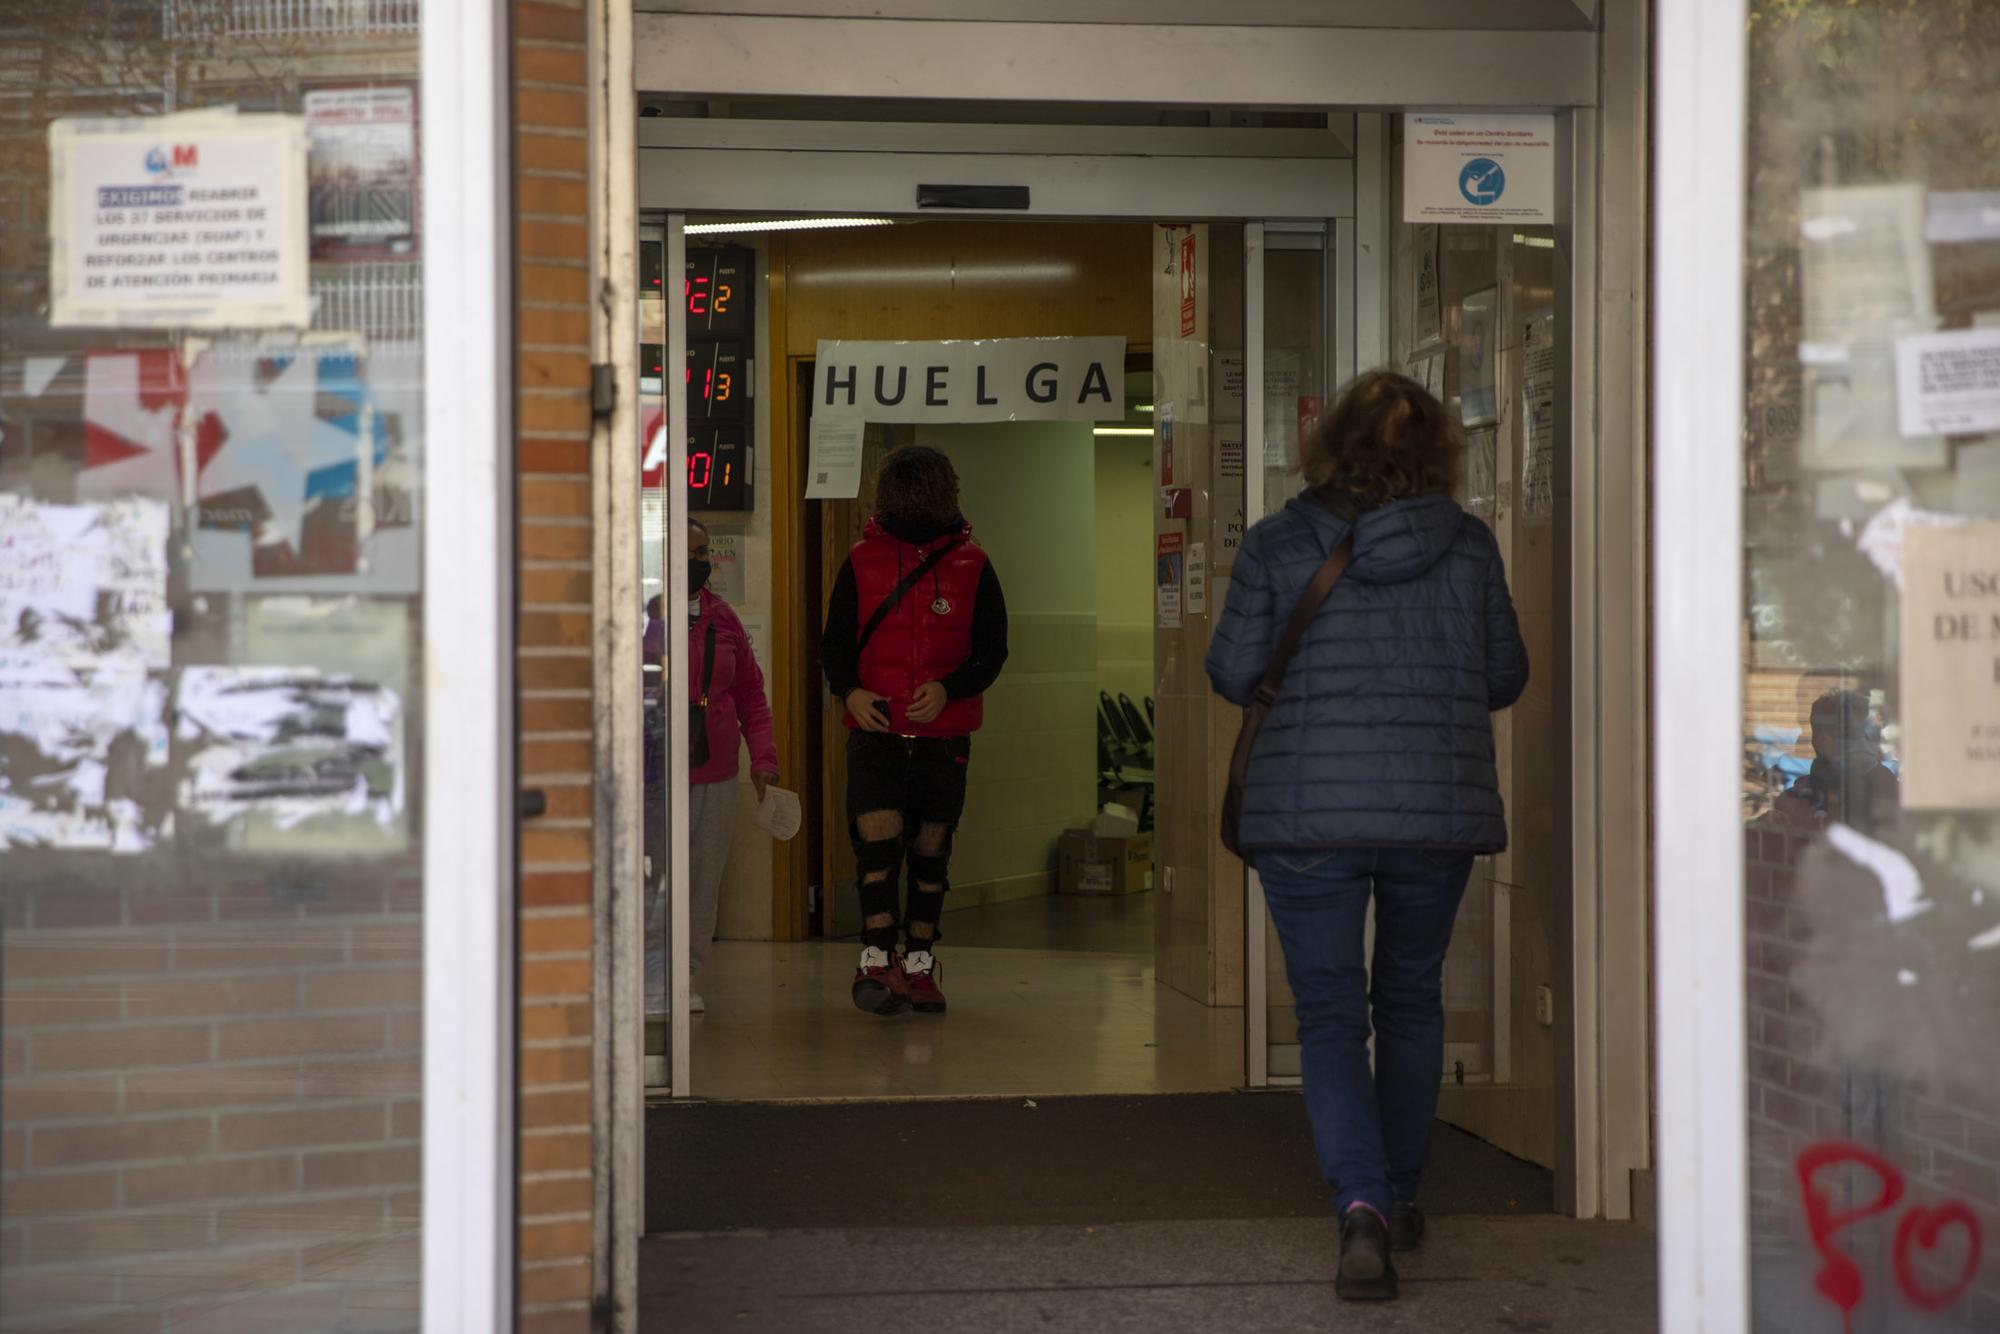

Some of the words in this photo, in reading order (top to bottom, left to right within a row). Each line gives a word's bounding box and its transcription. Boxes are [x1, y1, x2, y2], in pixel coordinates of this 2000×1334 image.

[188, 188, 259, 202] REABRIR
[94, 211, 126, 226] LOS
[130, 210, 150, 225] 37
[154, 209, 241, 225] SERVICIOS
[245, 207, 268, 222] DE
[98, 232, 189, 247] URGENCIAS
[85, 253, 166, 269] REFORZAR
[171, 251, 201, 266] LOS
[206, 250, 280, 265] CENTROS
[85, 275, 107, 290] DE
[198, 270, 280, 287] PRIMARIA
[825, 362, 1113, 407] HUELGA
